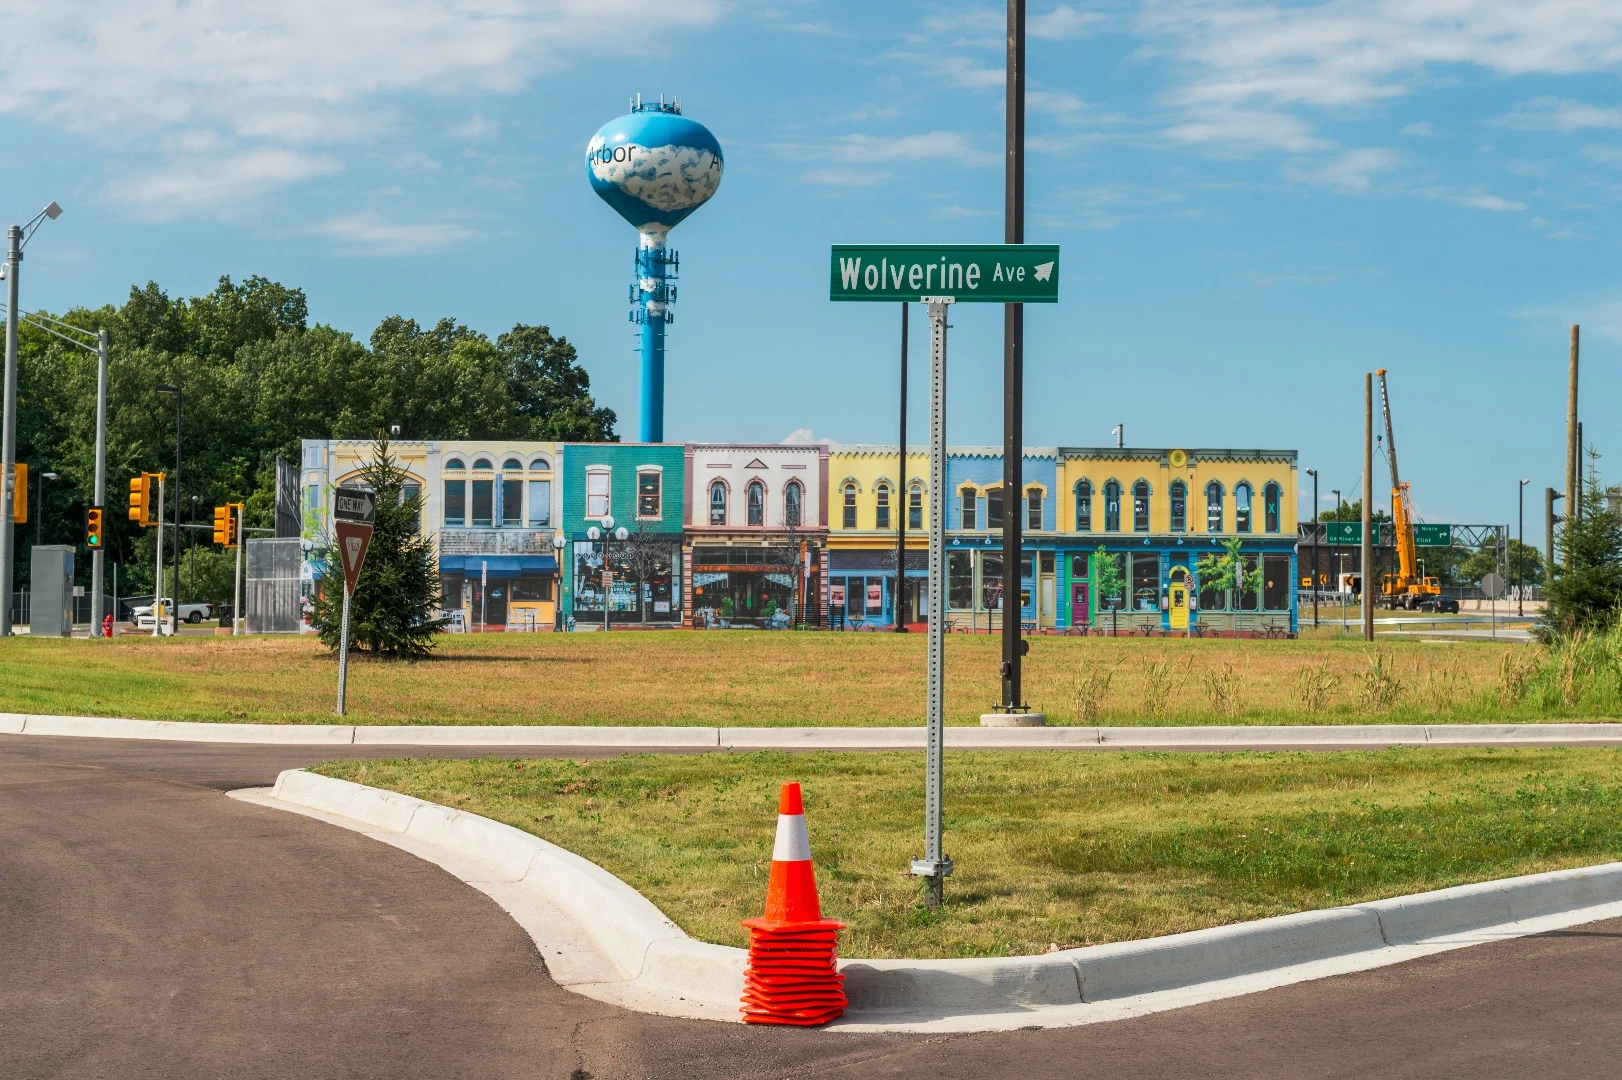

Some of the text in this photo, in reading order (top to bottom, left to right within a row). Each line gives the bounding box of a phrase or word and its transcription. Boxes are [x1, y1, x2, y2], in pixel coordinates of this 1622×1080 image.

[588, 143, 637, 168] Arbor
[839, 256, 1026, 291] Wolverine Ave
[340, 498, 365, 512] ONE WAY
[348, 542, 359, 551] YIELD
